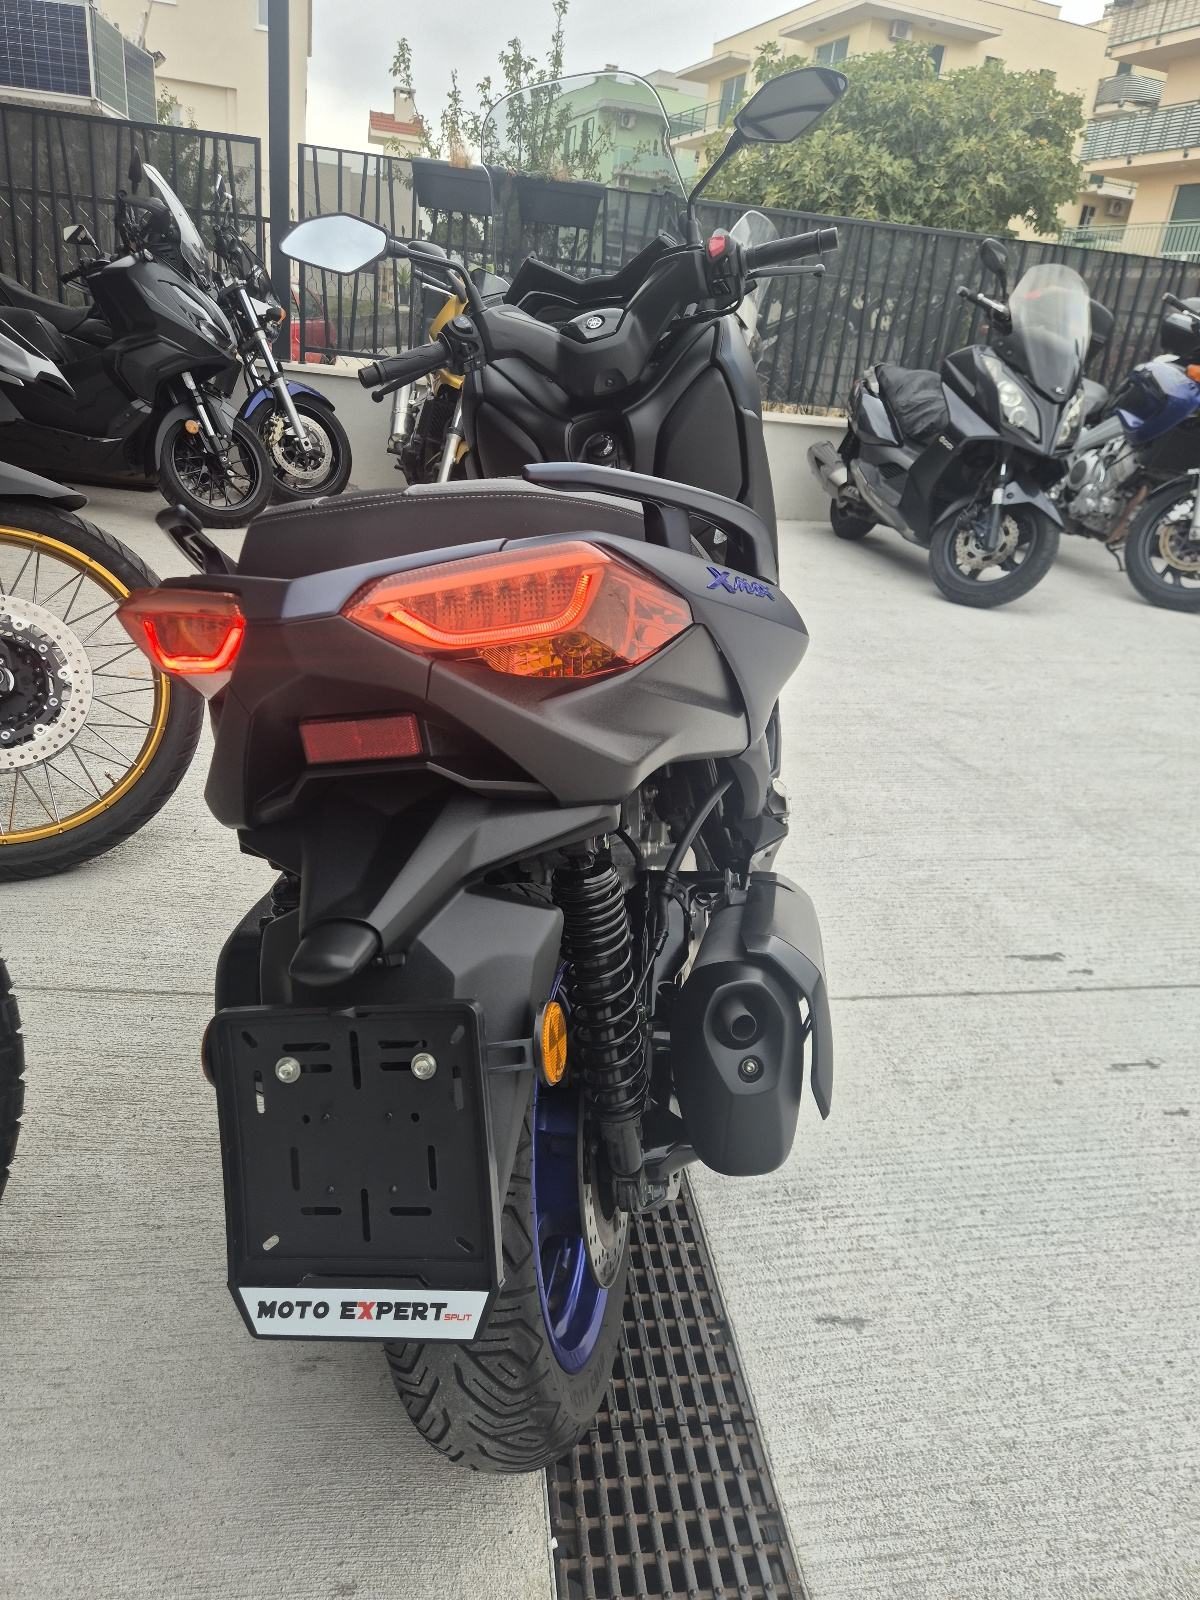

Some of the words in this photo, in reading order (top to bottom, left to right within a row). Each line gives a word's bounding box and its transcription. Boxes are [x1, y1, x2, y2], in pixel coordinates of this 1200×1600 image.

[257, 1301, 330, 1319] MOTO
[340, 1302, 448, 1321] EXPERT
[444, 1313, 473, 1321] SPLIT
